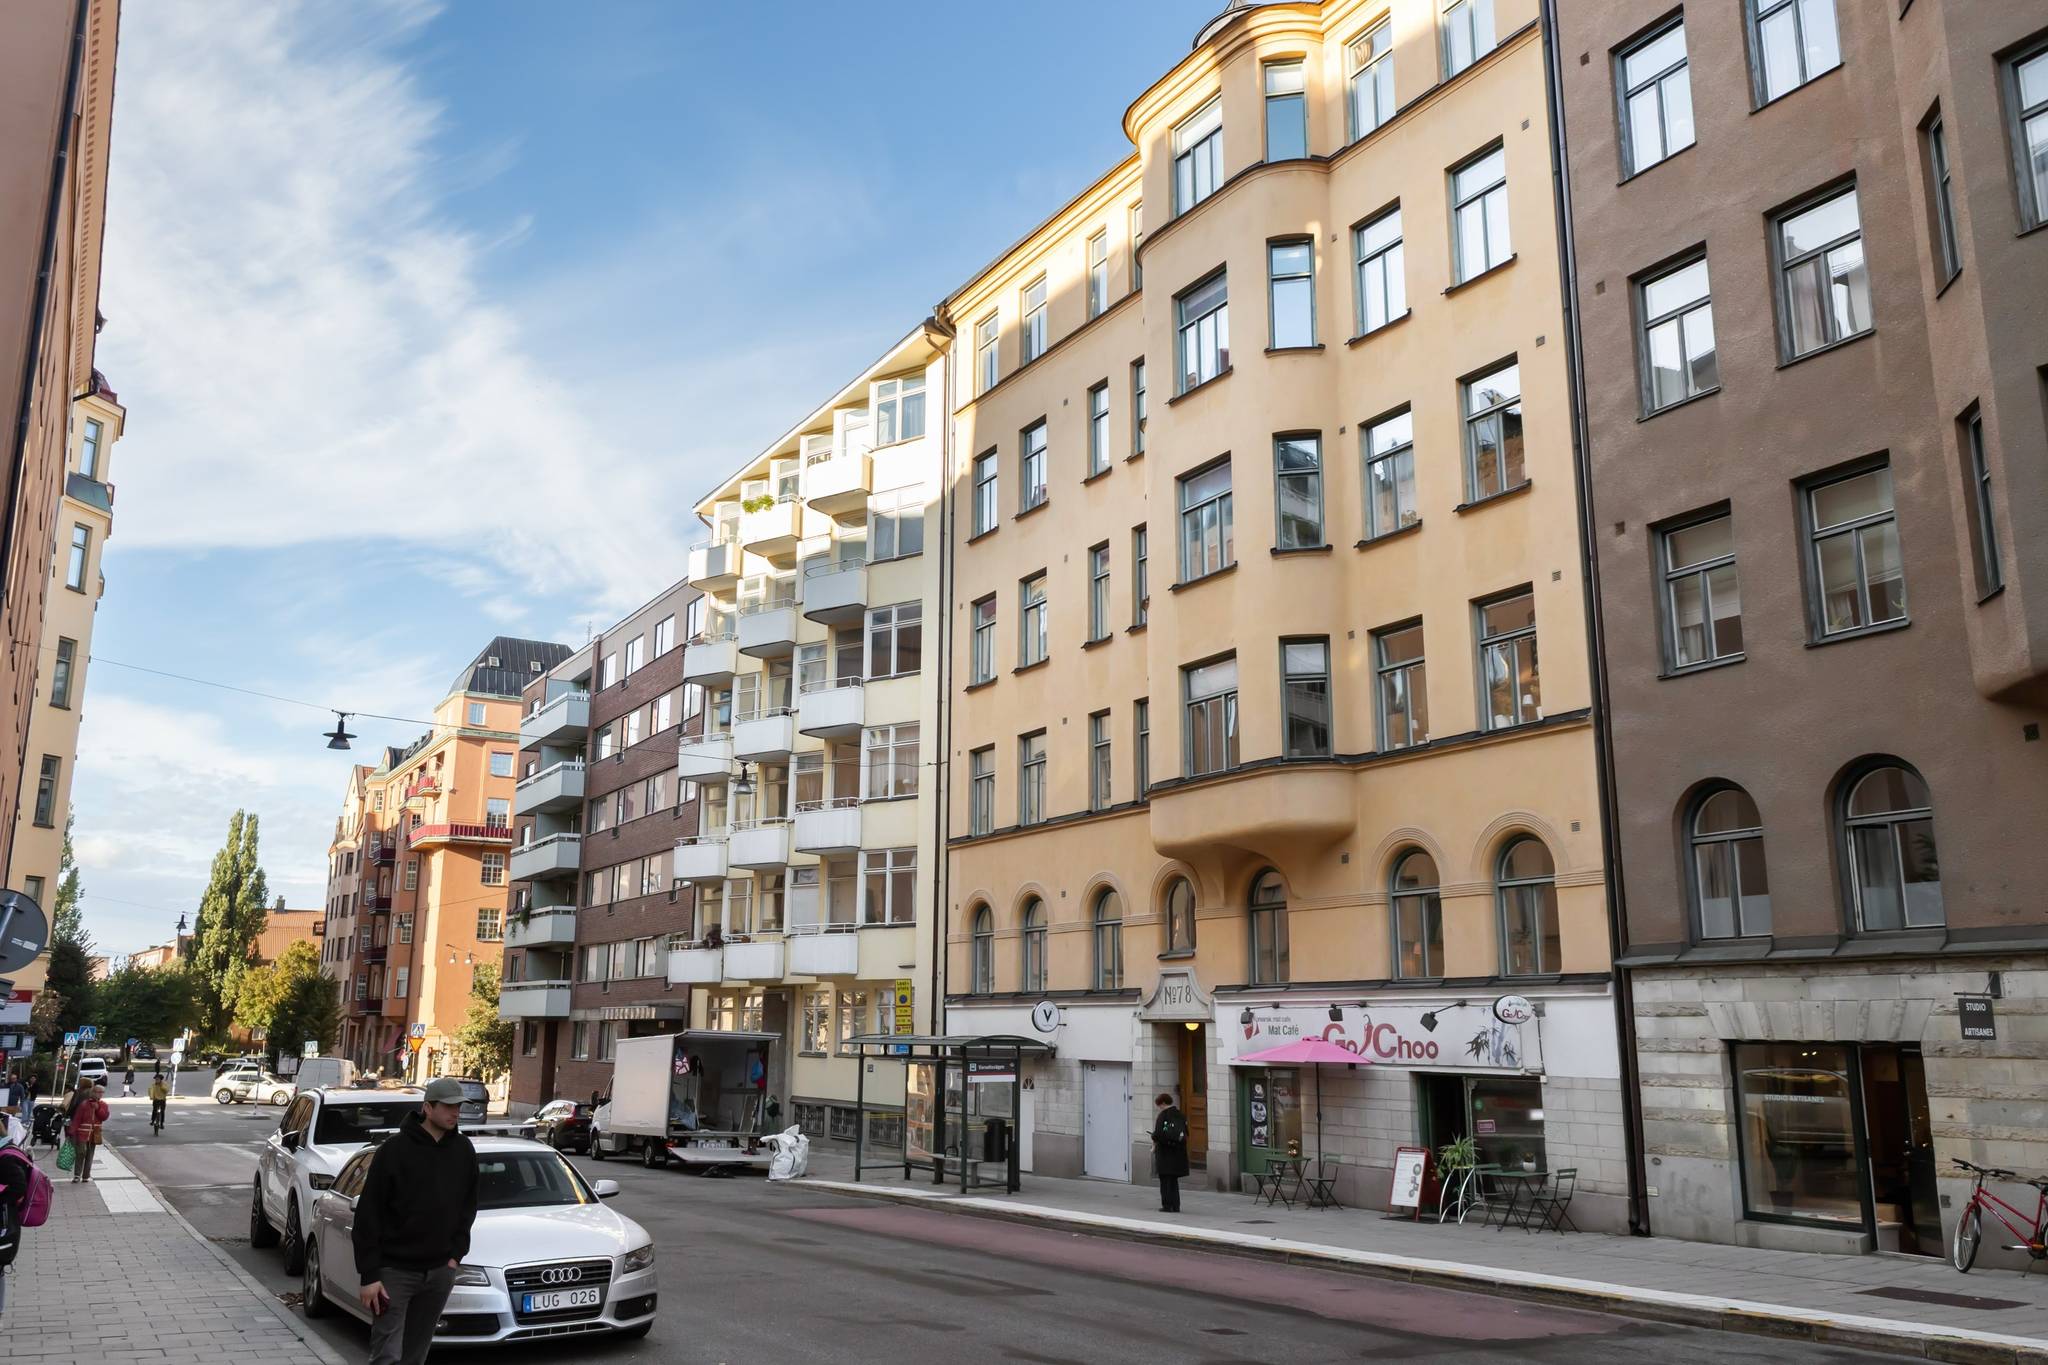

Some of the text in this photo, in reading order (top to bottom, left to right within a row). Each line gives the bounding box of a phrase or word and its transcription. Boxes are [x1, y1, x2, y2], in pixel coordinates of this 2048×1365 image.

[1965, 1002, 1987, 1011] STUDIO
[1043, 1009, 1053, 1023] V
[1268, 1024, 1300, 1035] Mat Café
[1964, 1027, 1994, 1037] ARTISANES
[1765, 1094, 1825, 1103] STUDIO ARTISANES
[533, 1289, 597, 1310] LUG 026
